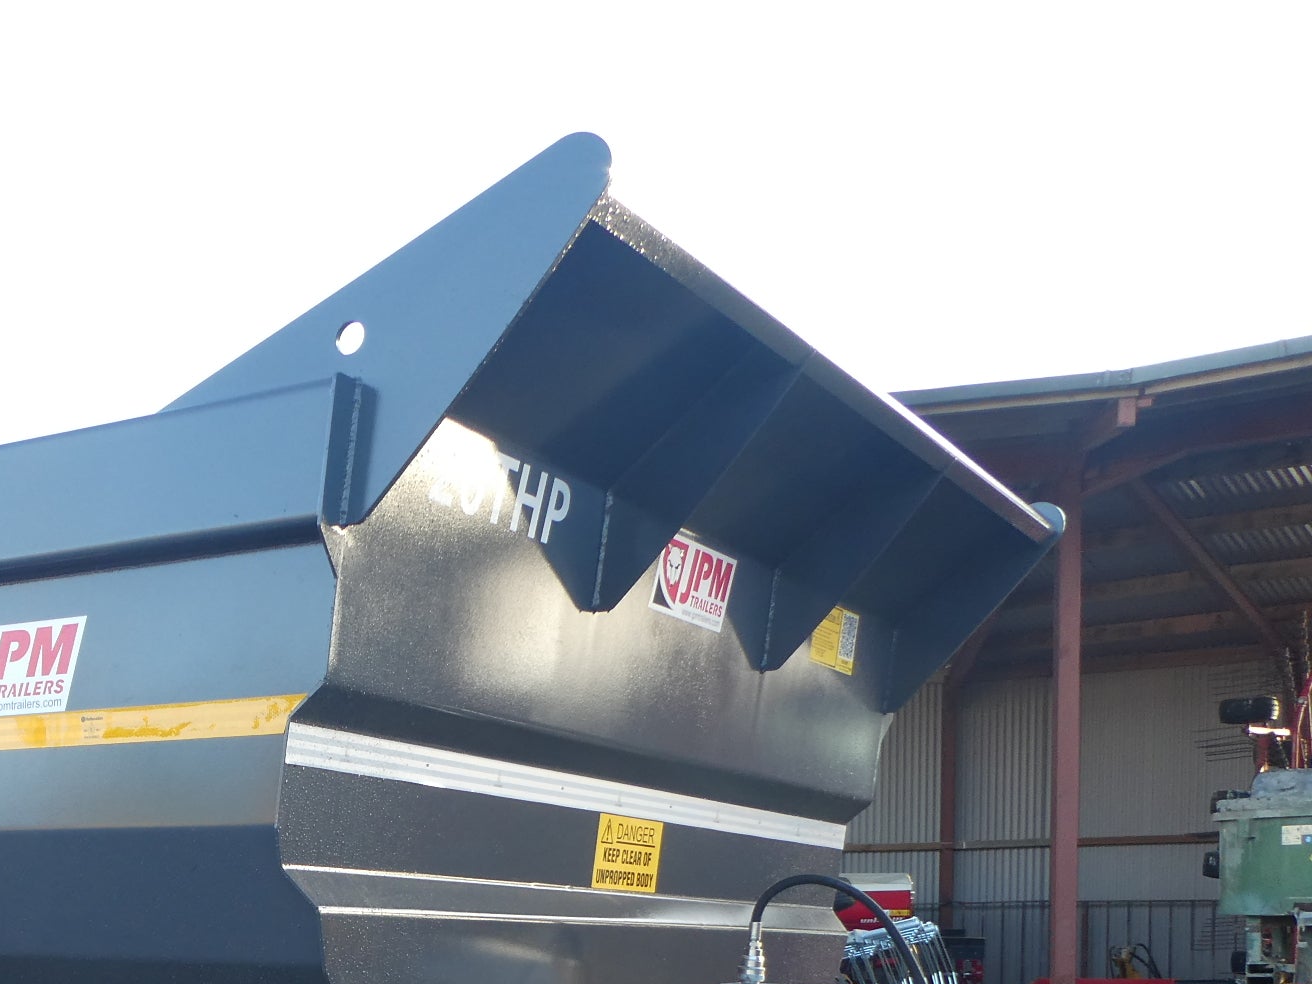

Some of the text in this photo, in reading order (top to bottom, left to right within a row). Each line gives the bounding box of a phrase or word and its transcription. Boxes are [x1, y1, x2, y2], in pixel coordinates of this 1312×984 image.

[428, 450, 571, 544] THP
[679, 548, 734, 604] JPM
[689, 595, 723, 618] TRAILERS
[616, 823, 655, 844] DANGER
[602, 847, 652, 867] KEEP CLEAR OF
[595, 868, 654, 888] UNPROPPED BODY
